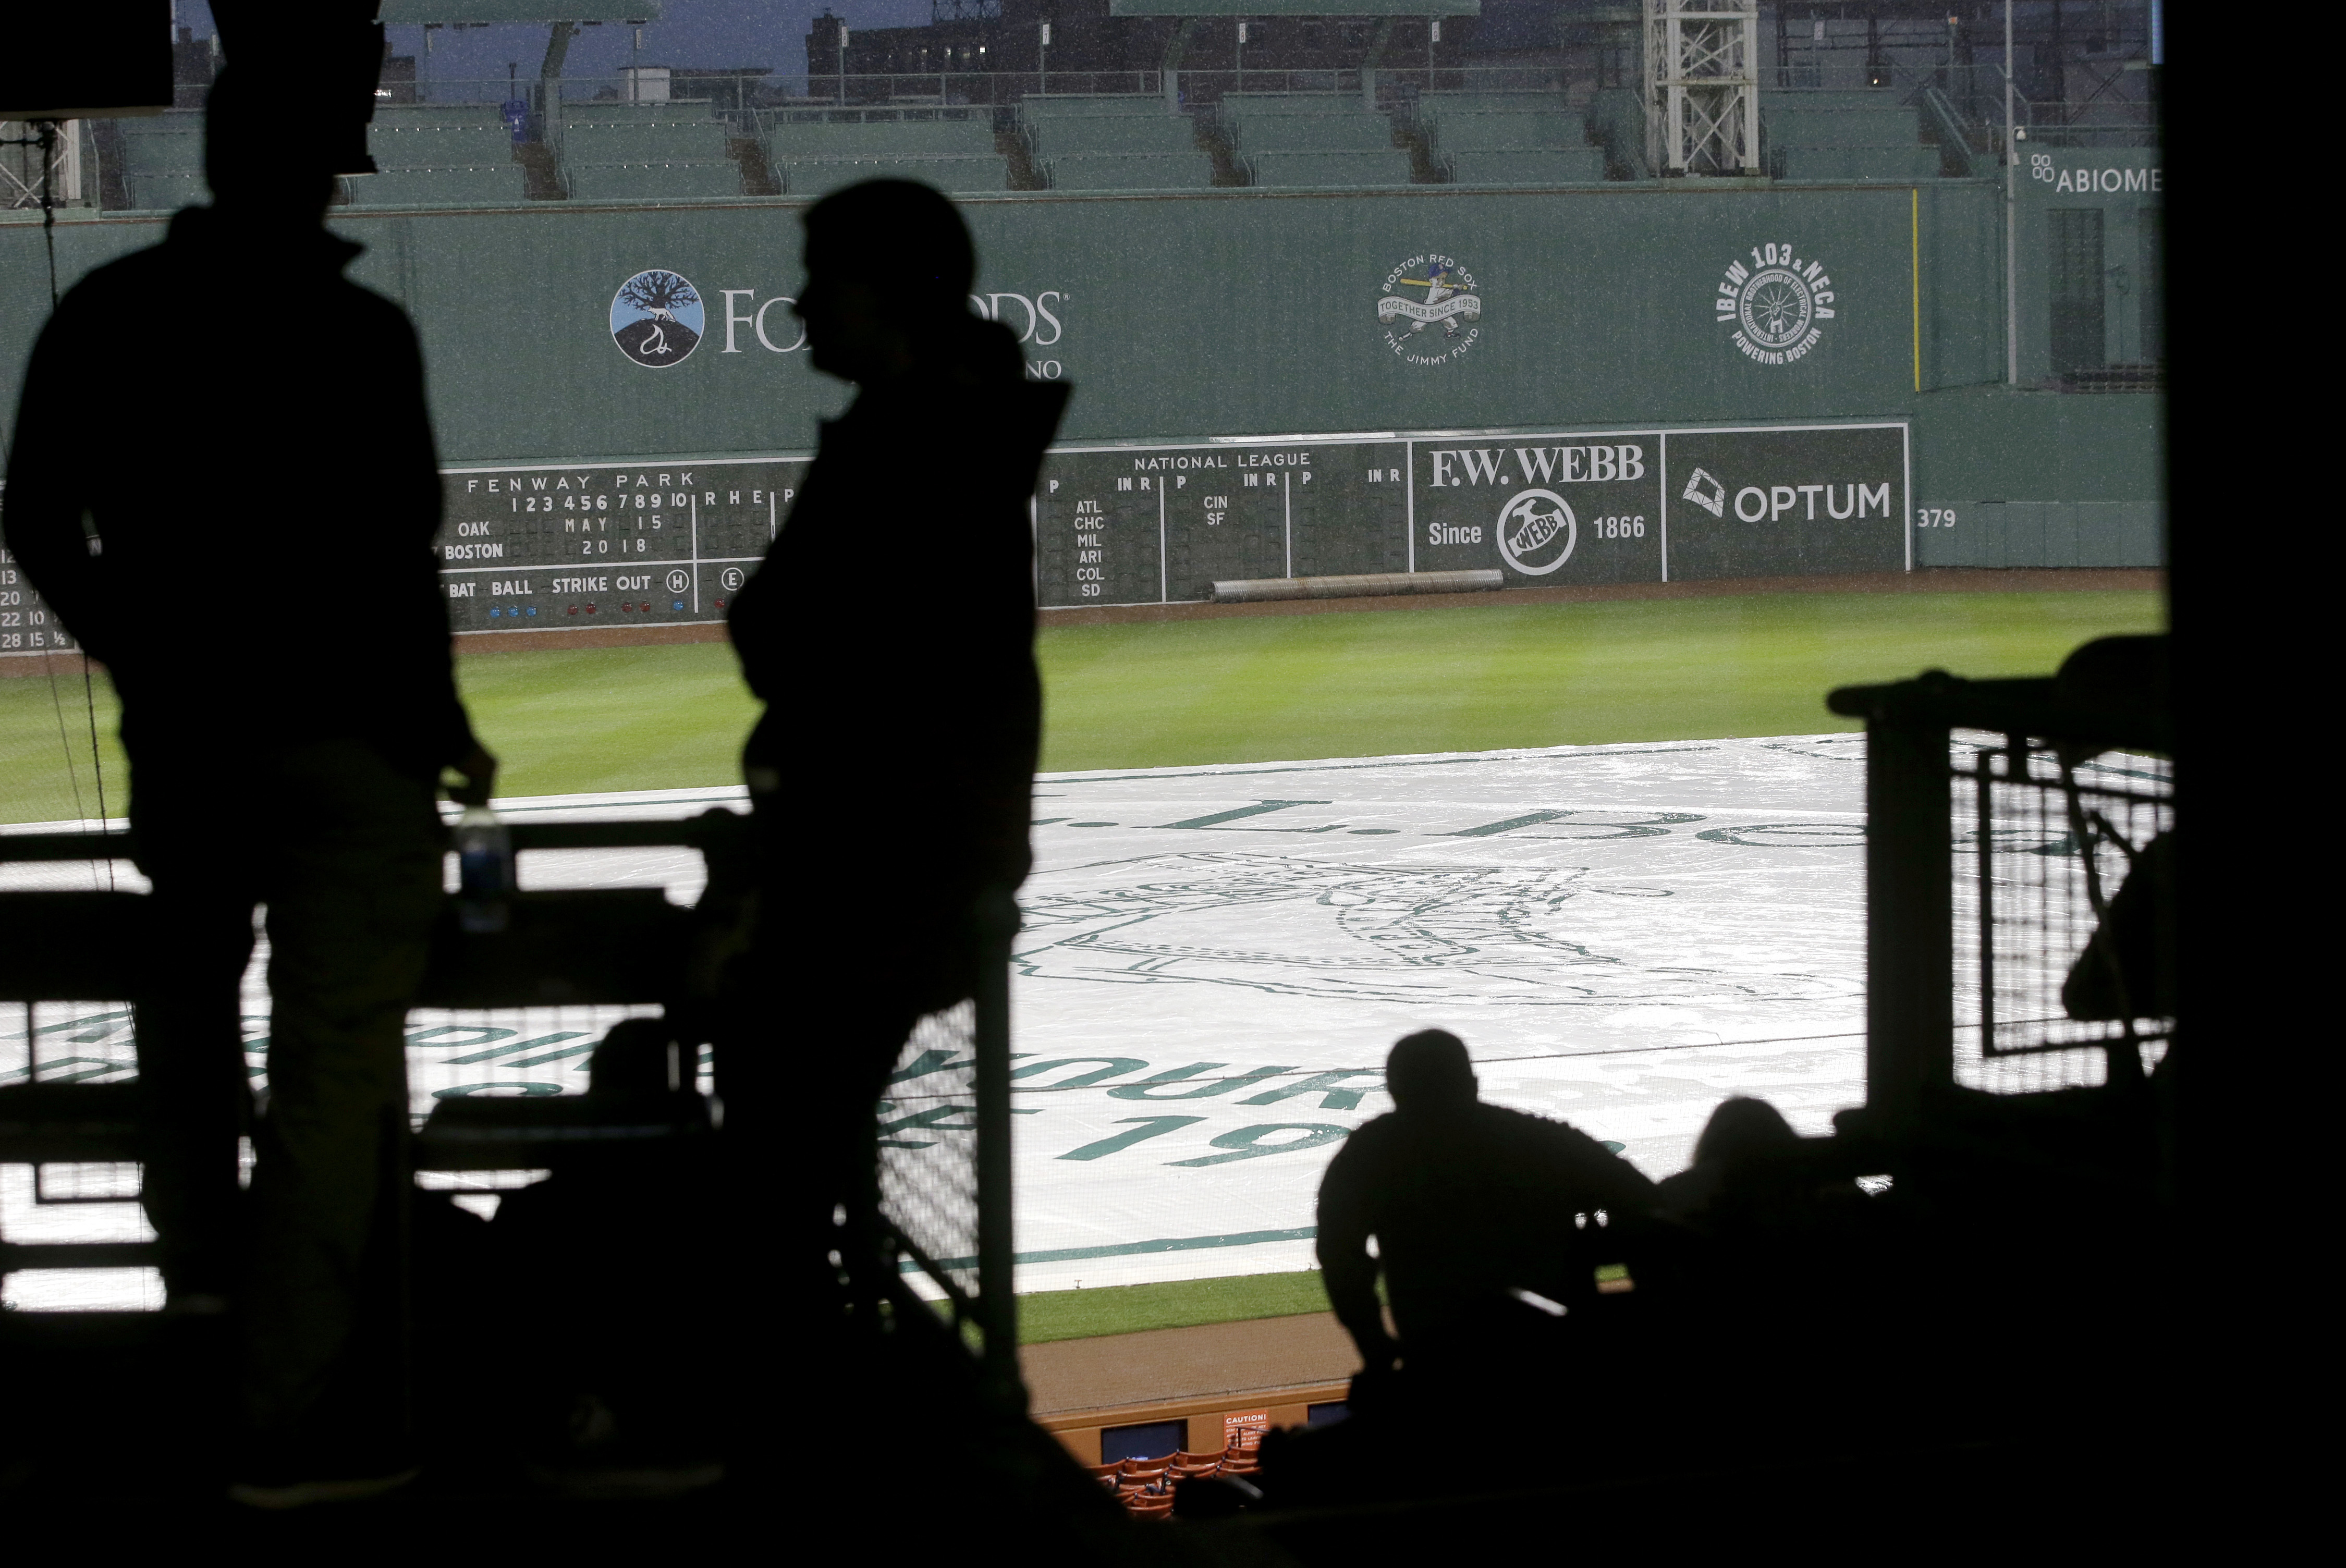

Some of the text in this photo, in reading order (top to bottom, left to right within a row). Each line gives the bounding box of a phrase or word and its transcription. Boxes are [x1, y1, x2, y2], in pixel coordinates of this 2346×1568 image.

[1382, 254, 1477, 292] BOSTON RED SOX
[1716, 243, 1835, 322] IBEW 103 & NECA
[1380, 299, 1479, 317] TOGETHER SINCE 1953
[1744, 274, 1807, 342] INTERNATIONAL BROTHERHOOD OF ELECTRICAL WORKERS
[1384, 328, 1478, 365] THE JIMMY FUND
[1731, 327, 1822, 364] POWERING BOSTON
[1135, 453, 1311, 470] NATIONAL LEAGUE
[1429, 445, 1645, 487] F.W. WEBB
[468, 472, 693, 493] FENWAY PARK
[1049, 477, 1151, 493] P IN R
[1177, 473, 1276, 489] P IN R
[1302, 469, 1400, 485] P IN R
[671, 493, 687, 507] 10
[785, 488, 794, 503] P
[1204, 496, 1228, 509] CIN
[1734, 483, 1891, 523] OPTUM
[1076, 500, 1102, 514] ATL
[458, 515, 661, 537] OAK MAY 15
[1074, 517, 1105, 530] CHC
[1207, 512, 1224, 526] SF
[1594, 516, 1645, 538] 1866
[1917, 509, 1956, 528] 379
[1077, 534, 1102, 547] MIL
[1429, 522, 1482, 545] Since
[1516, 515, 1558, 550] WEBB
[445, 538, 646, 559] BOSTON 2018
[1079, 550, 1102, 563] ARI
[1, 569, 17, 585] 13
[1077, 567, 1105, 581] COL
[449, 572, 737, 598] BAT BALL STRIKE OUT H E
[1082, 583, 1101, 596] SD
[0, 591, 20, 606] 20
[1, 612, 21, 627] 22
[29, 611, 44, 626] 10
[2, 633, 21, 648] 28
[30, 632, 44, 647] 15
